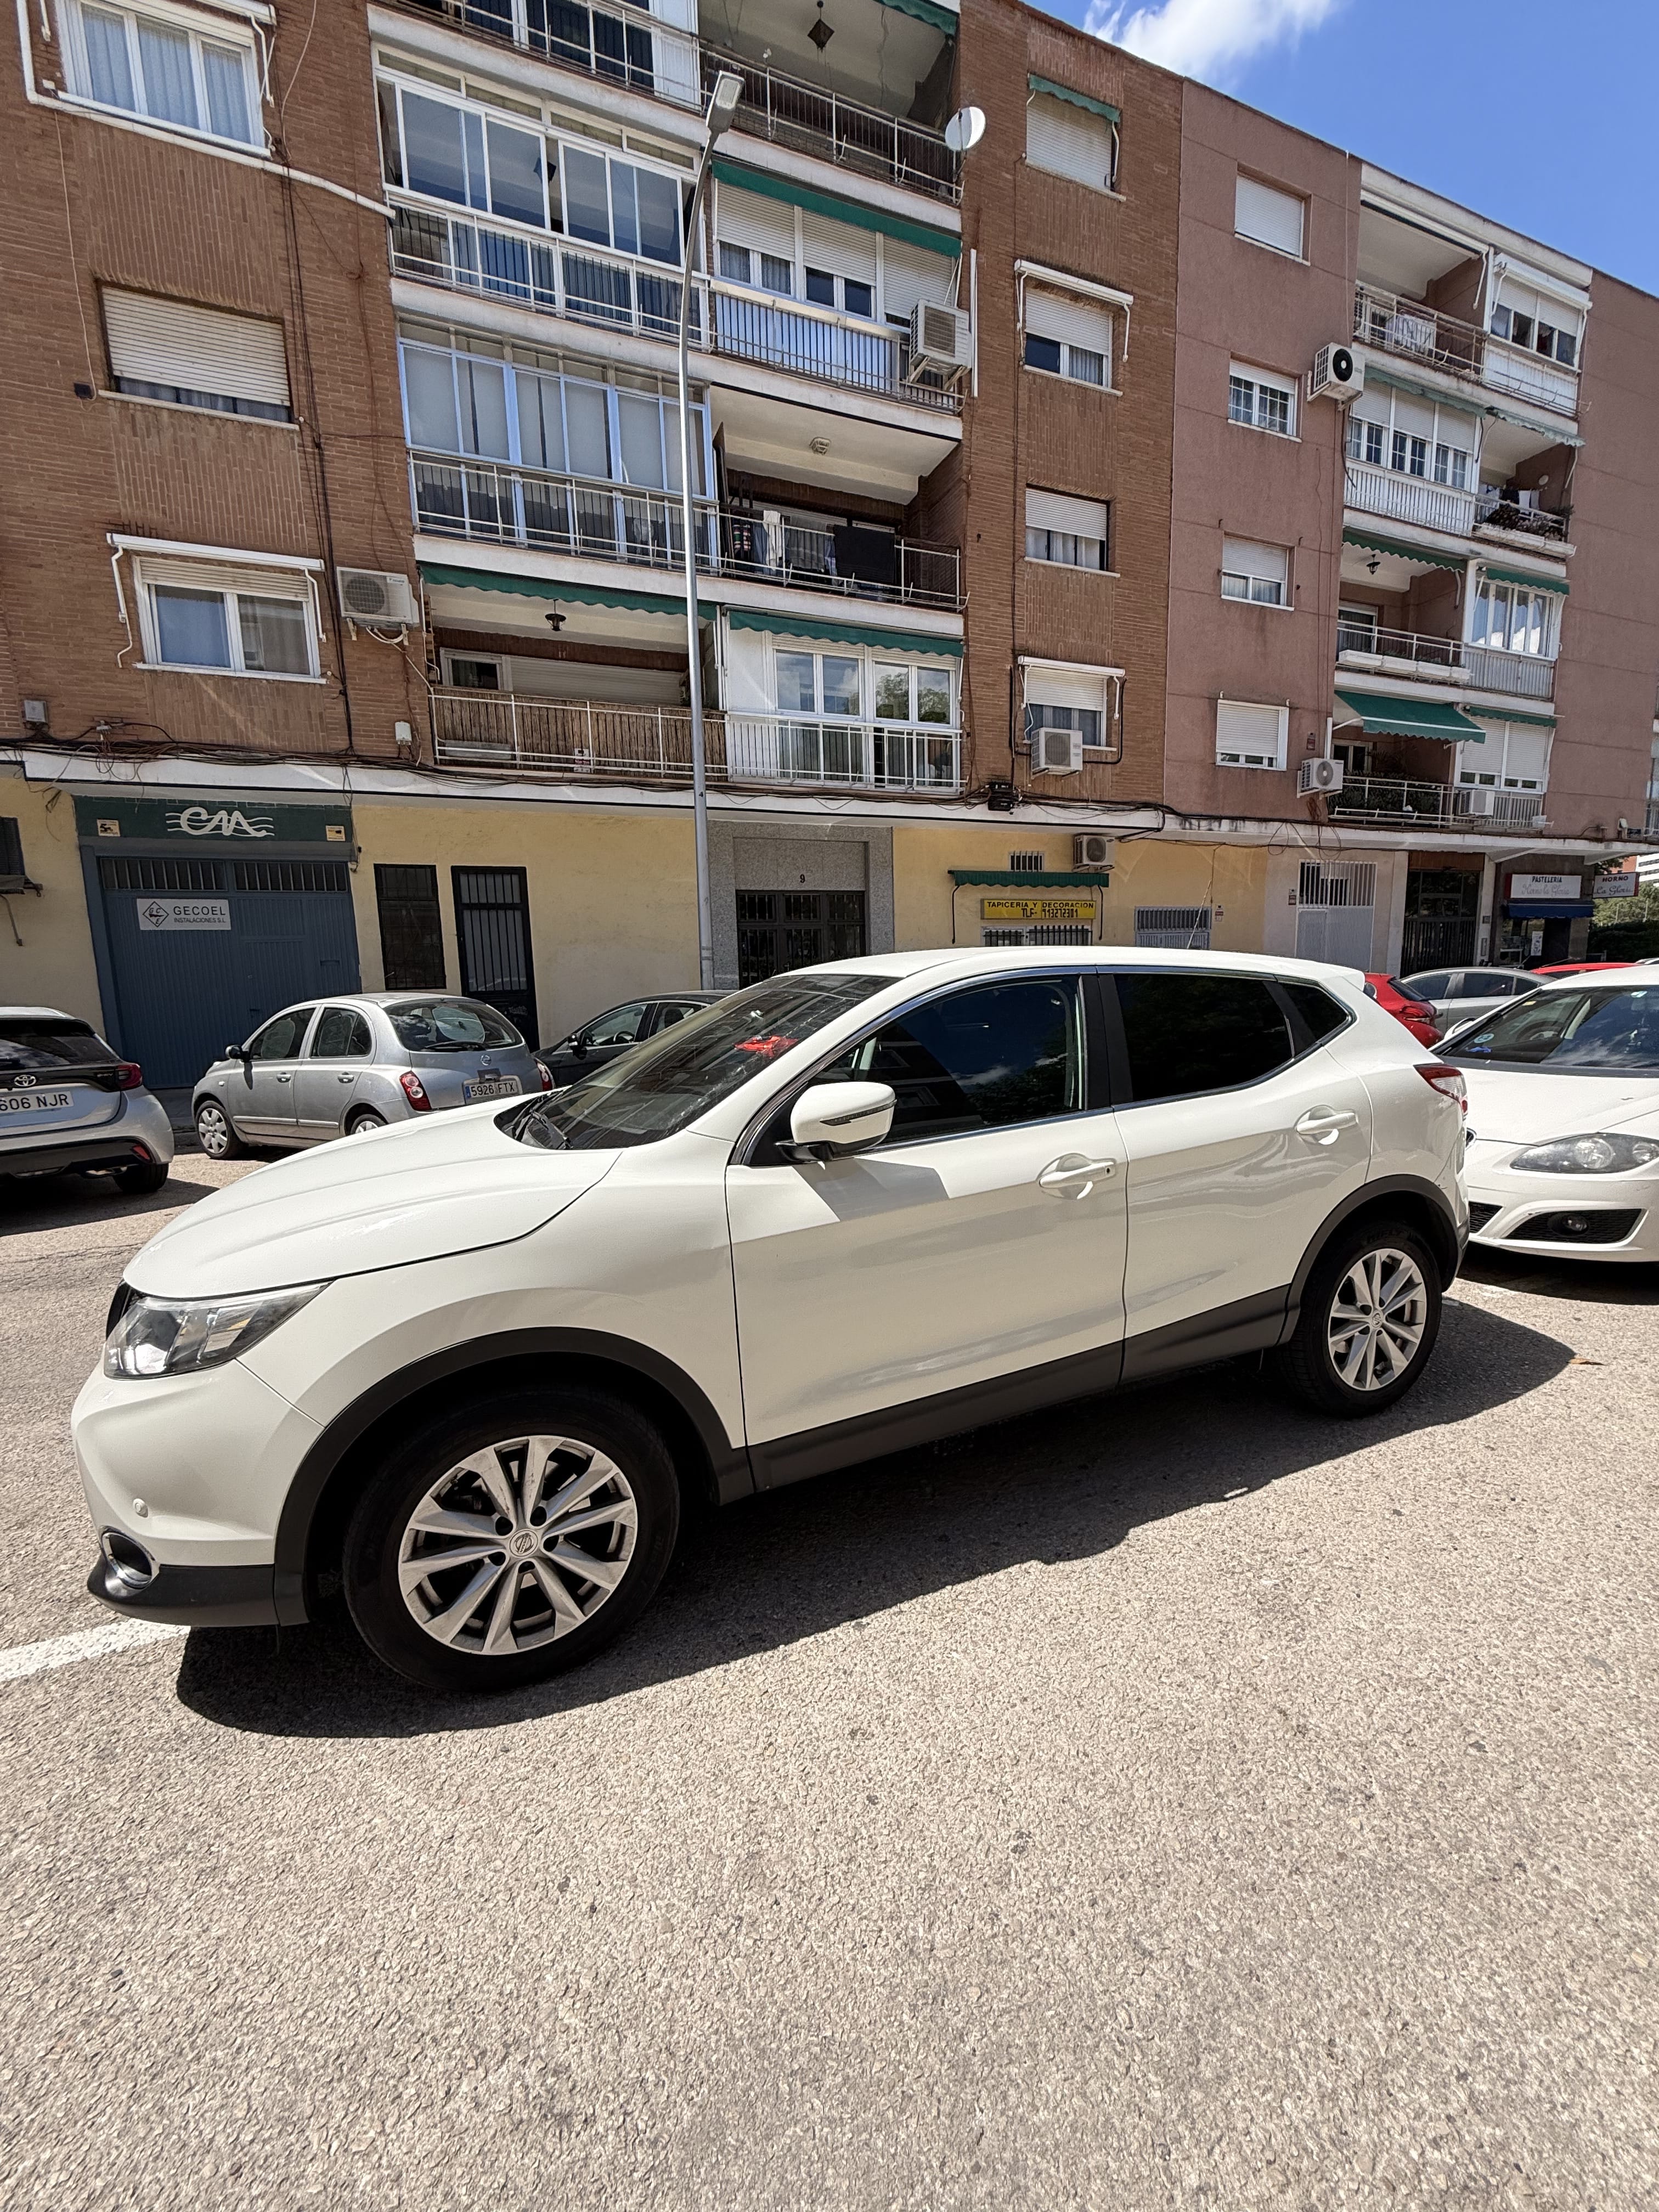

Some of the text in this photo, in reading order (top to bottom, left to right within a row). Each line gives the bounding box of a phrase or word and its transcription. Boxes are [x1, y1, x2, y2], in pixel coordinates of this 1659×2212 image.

[799, 873, 805, 883] 9
[173, 906, 227, 916] GECOEL
[1042, 908, 1079, 918] 913272301
[471, 1082, 515, 1097] 5926 FTX
[36, 1093, 69, 1108] NJR
